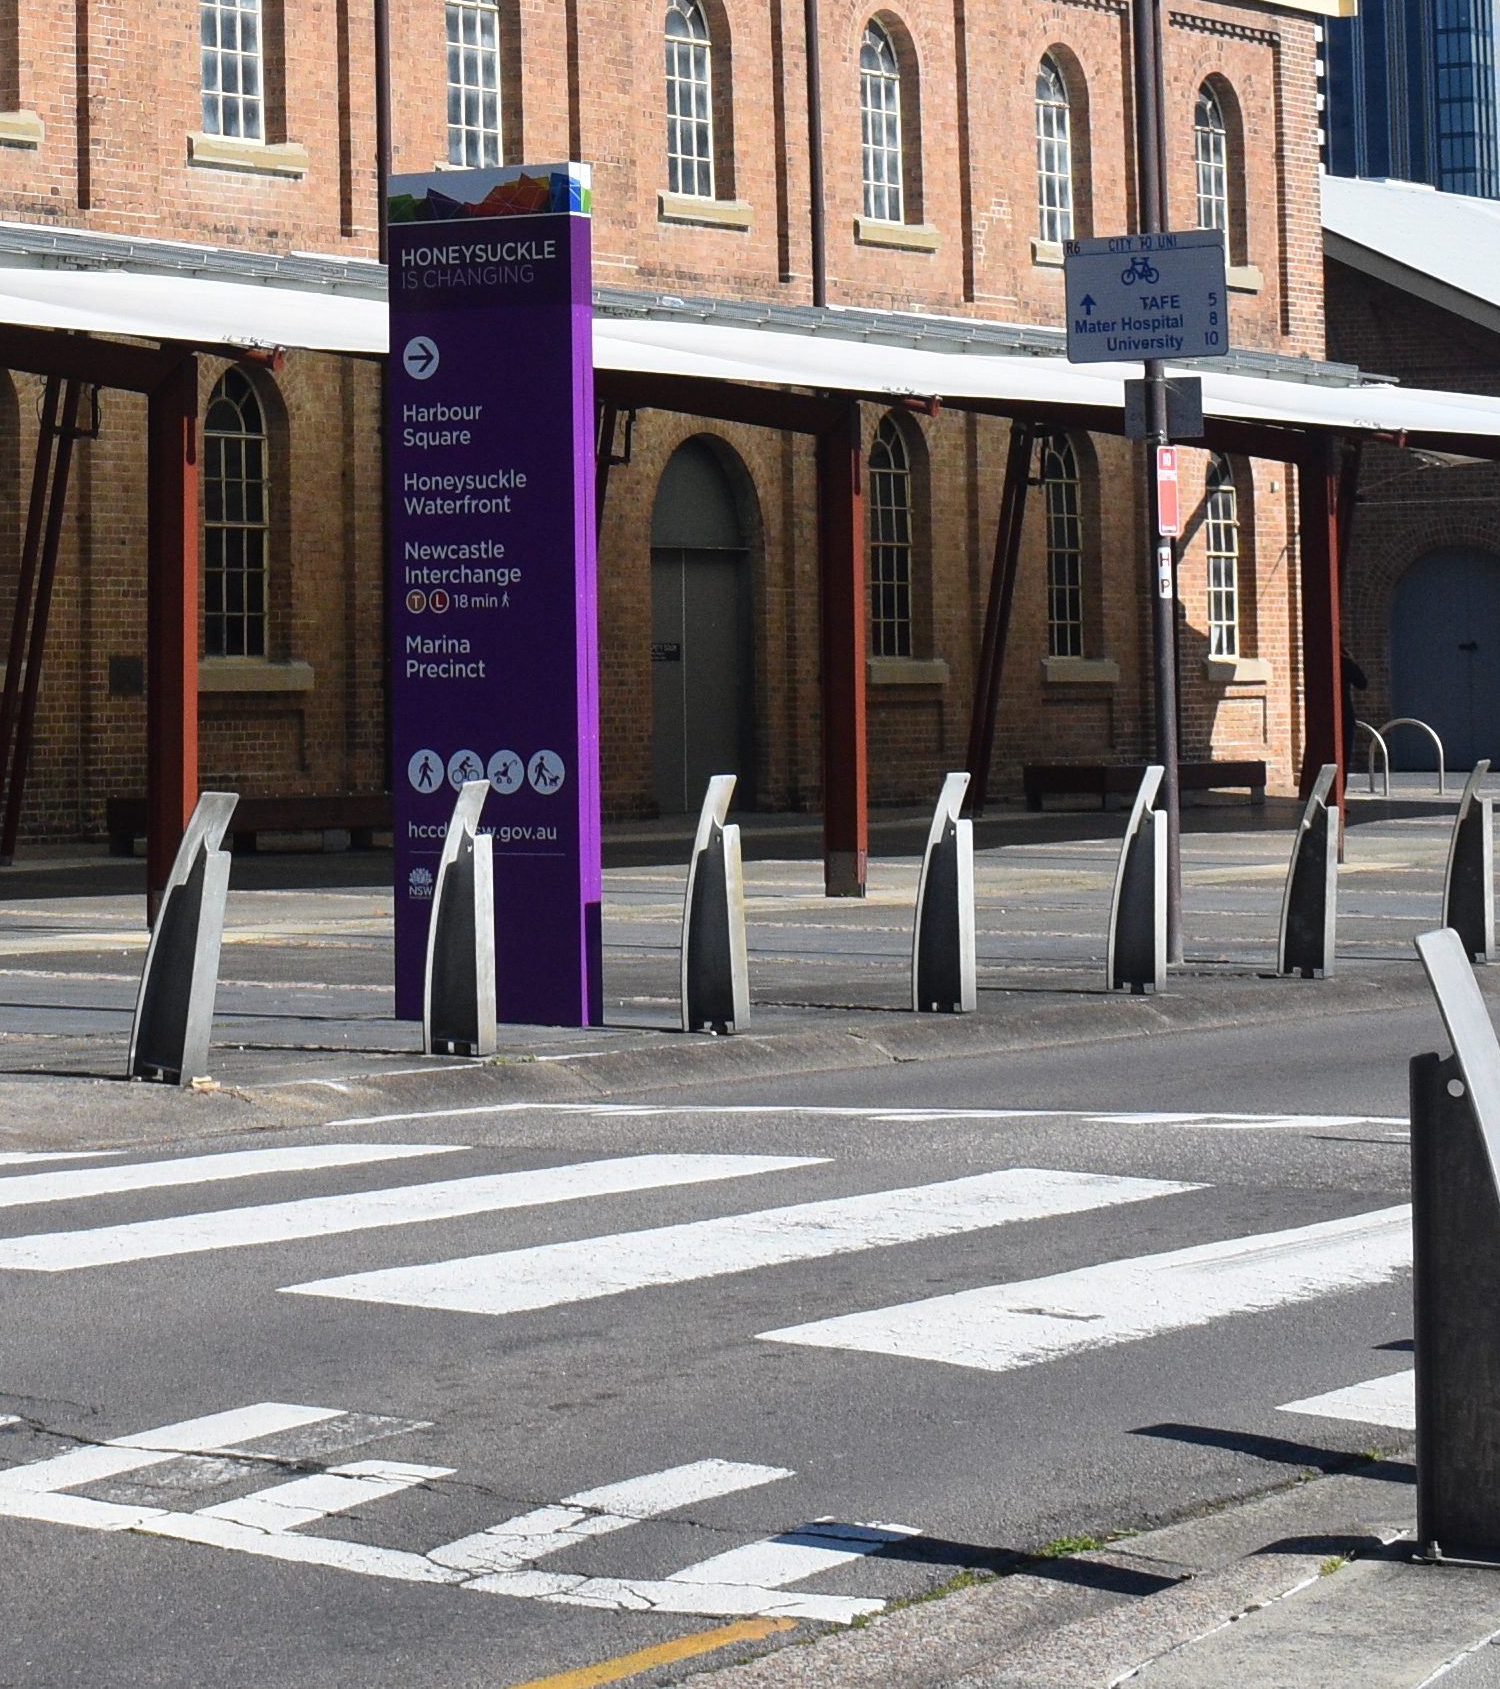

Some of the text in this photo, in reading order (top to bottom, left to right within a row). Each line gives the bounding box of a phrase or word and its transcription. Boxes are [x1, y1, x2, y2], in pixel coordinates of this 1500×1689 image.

[401, 240, 556, 268] HONEYSUCKLE
[1066, 234, 1177, 255] R6 CITY TO UNI
[402, 265, 535, 290] IS CHANGING
[1140, 292, 1217, 310] TAFE 5
[1075, 312, 1218, 334] Mater Hospital 8
[1106, 331, 1218, 352] University 10
[403, 403, 483, 423] Harbour
[403, 428, 472, 449] Square
[404, 469, 527, 494] Honeysuckle
[405, 495, 511, 516] Waterfront
[405, 540, 505, 560] Newcastle
[1160, 552, 1170, 567] H
[405, 565, 522, 587] Interchange
[1161, 578, 1170, 593] P
[453, 594, 469, 609] 18
[471, 593, 498, 608] min
[406, 635, 471, 654] Marina
[406, 659, 486, 679] Precinct
[408, 821, 557, 843] hccdsw.gov.au
[409, 885, 433, 896] NSW
